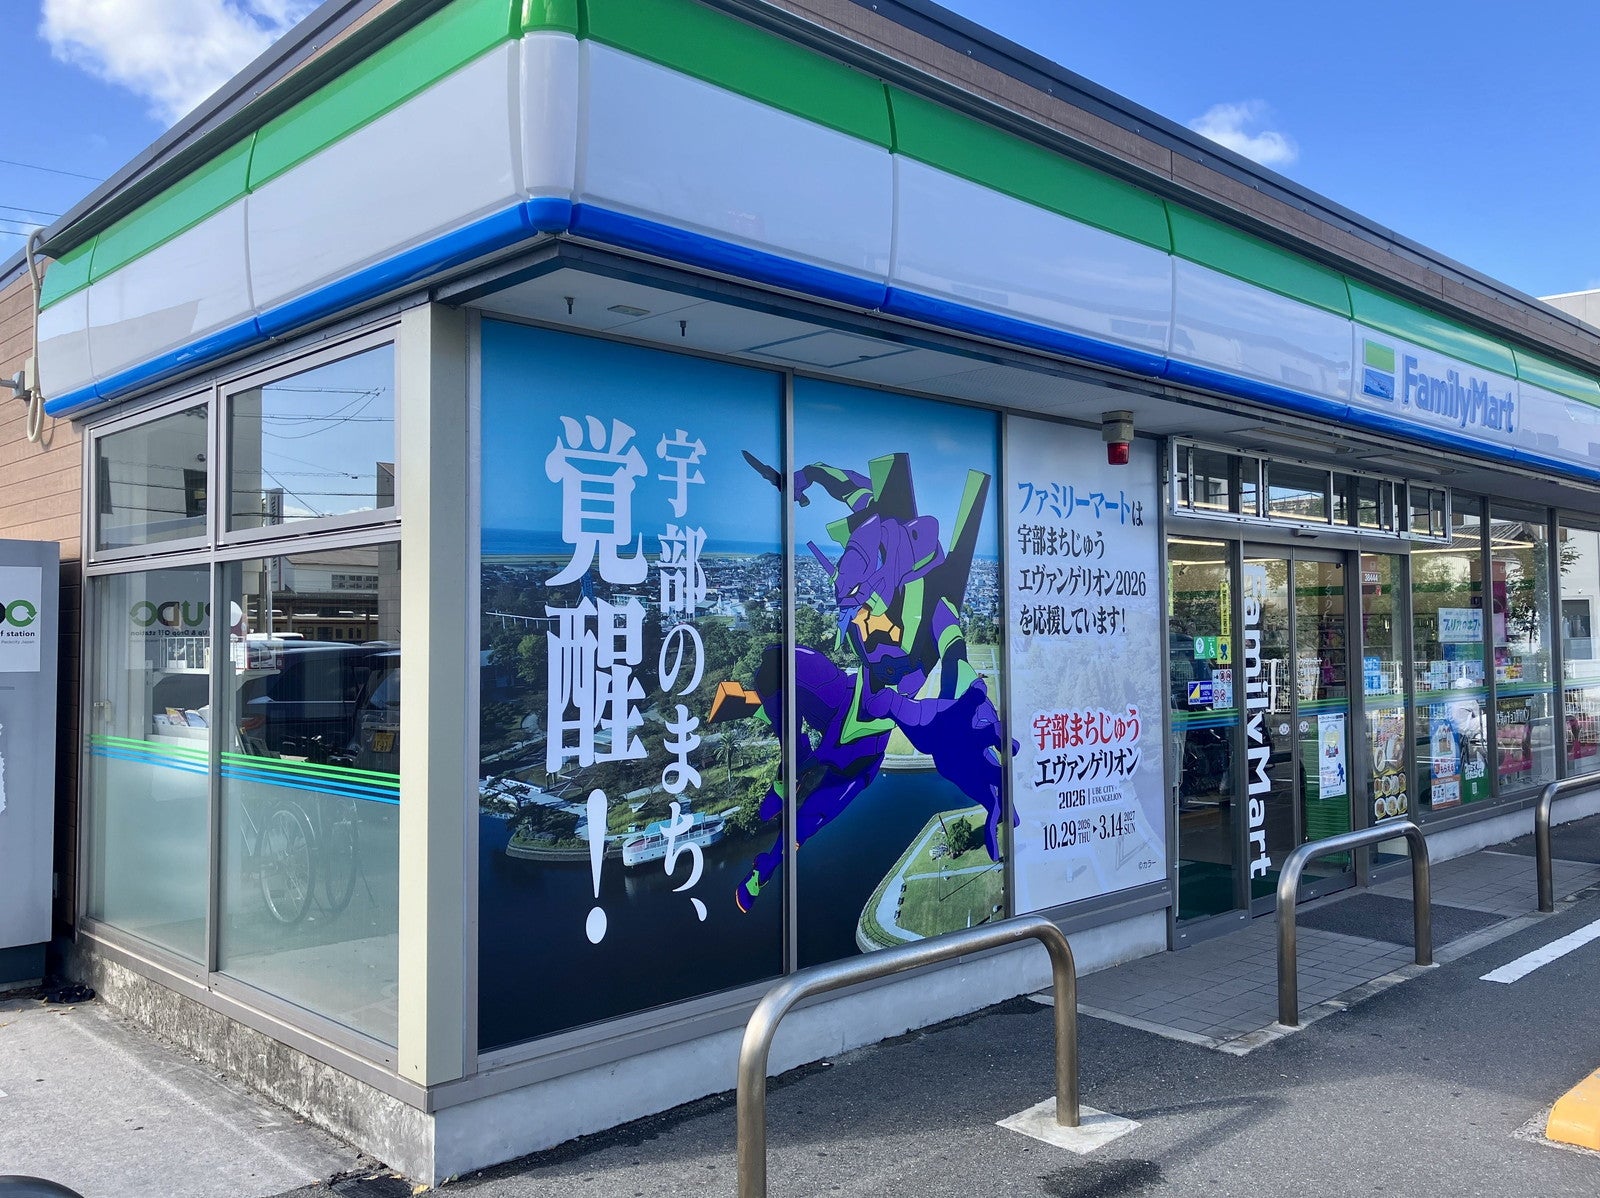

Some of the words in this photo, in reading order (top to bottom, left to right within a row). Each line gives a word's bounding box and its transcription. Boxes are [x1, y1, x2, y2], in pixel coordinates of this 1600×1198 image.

[1402, 354, 1515, 433] FamilyMart
[1018, 481, 1143, 526] ファミリーマートは
[1018, 524, 1105, 559] 宇部まちじゅう
[1018, 563, 1146, 597] エヴァンゲリオン2026
[1020, 605, 1126, 636] を応援しています！
[545, 415, 648, 945] 覚醒！
[656, 429, 709, 922] 宇部のまち、
[1033, 709, 1139, 751] 宇部まちじゅう
[1035, 748, 1140, 787] エヴァンゲリオン
[1059, 790, 1086, 809] 2026
[1092, 792, 1122, 804] EVANGELION
[1043, 820, 1077, 851] 10.29
[1099, 812, 1124, 840] 3.14
[1077, 819, 1091, 830] 2026
[1124, 811, 1136, 822] 2027
[1124, 822, 1136, 835] SUN
[1078, 831, 1091, 844] THU
